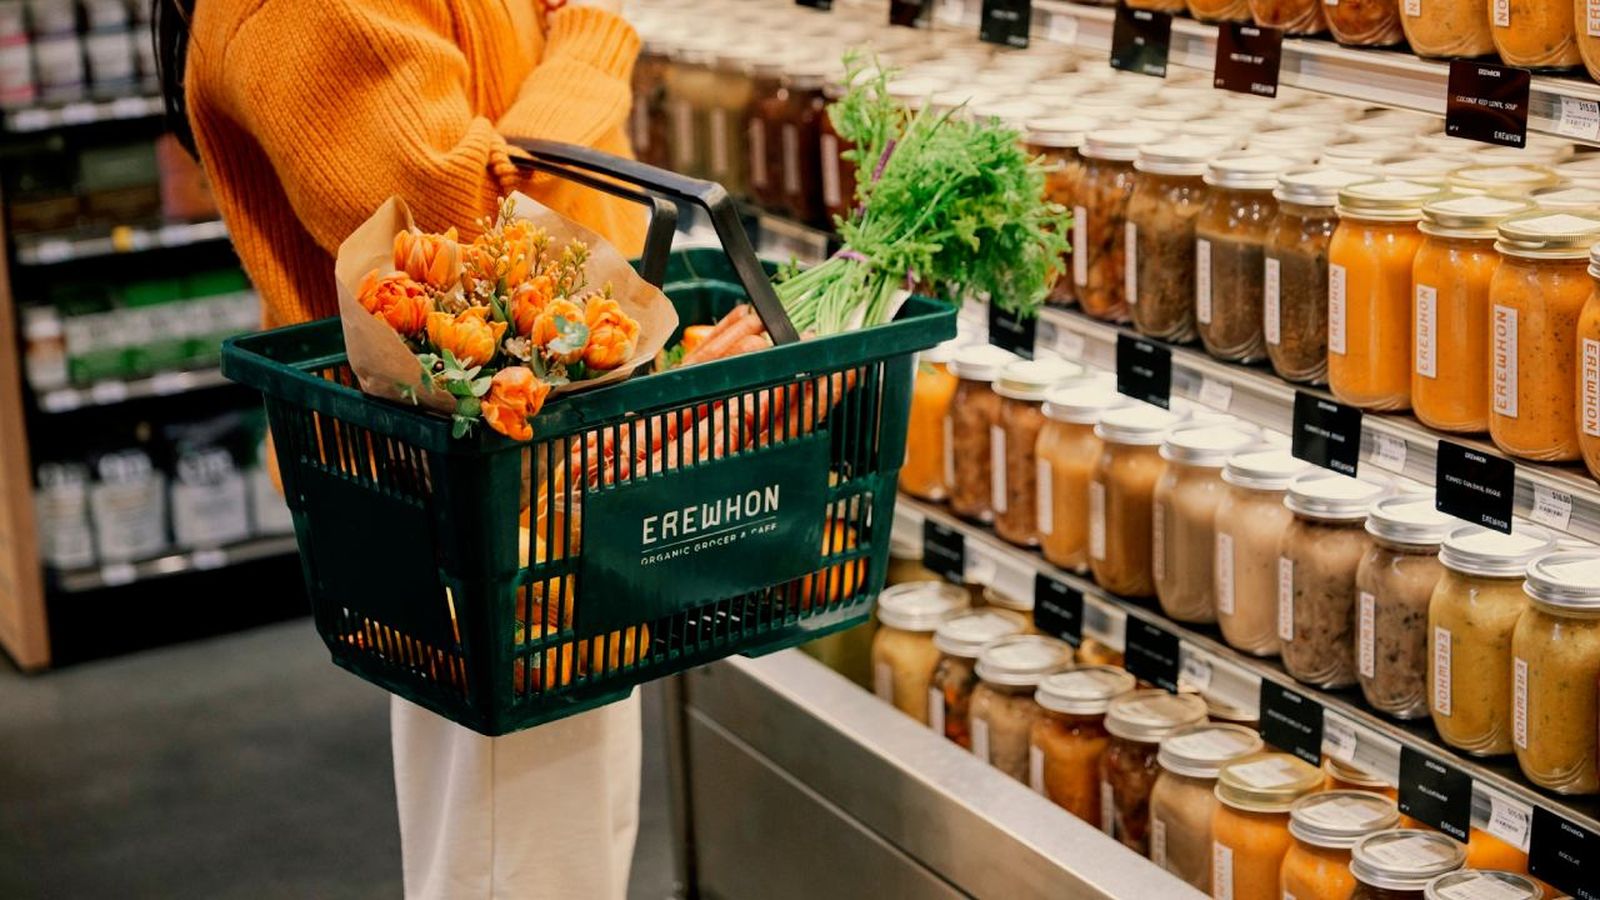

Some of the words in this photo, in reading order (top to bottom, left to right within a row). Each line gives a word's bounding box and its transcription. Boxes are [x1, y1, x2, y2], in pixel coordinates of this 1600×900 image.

[1420, 289, 1430, 371] EREWHON
[1497, 311, 1507, 410] EREWHON
[1586, 343, 1598, 432] EREWHON
[640, 546, 691, 566] ORGANIC
[694, 534, 737, 553] GROCER
[642, 484, 780, 545] EREWHON
[1438, 632, 1450, 712] EREWHON
[1516, 663, 1526, 745] EREWHON
